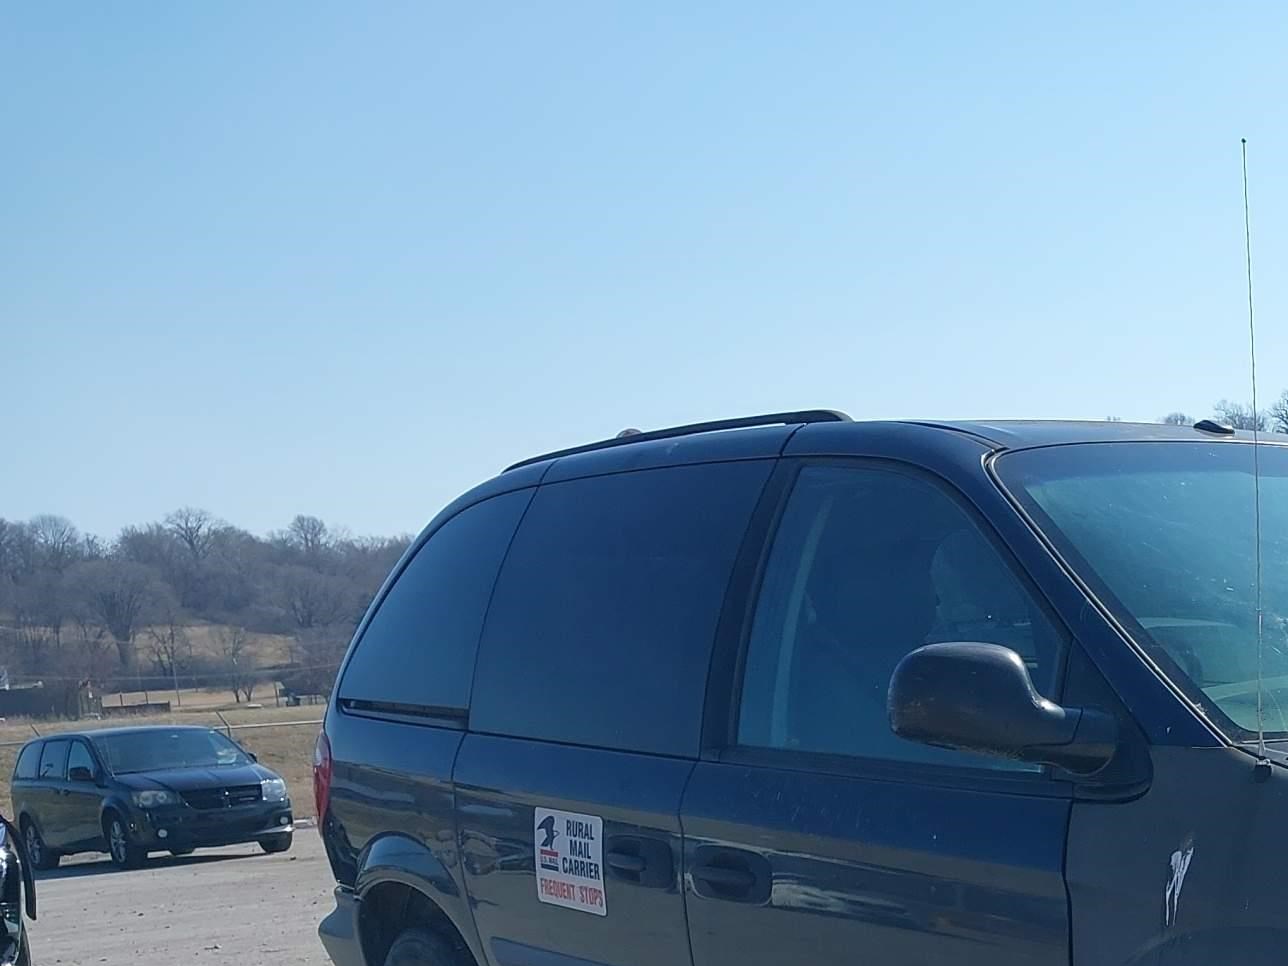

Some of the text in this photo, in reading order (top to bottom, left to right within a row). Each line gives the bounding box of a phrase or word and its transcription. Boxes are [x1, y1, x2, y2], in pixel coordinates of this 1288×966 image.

[566, 819, 594, 840] RURAL
[569, 839, 592, 859] MAIL
[562, 857, 600, 880] CARRIER
[541, 878, 603, 907] FREQUENT STOPS
